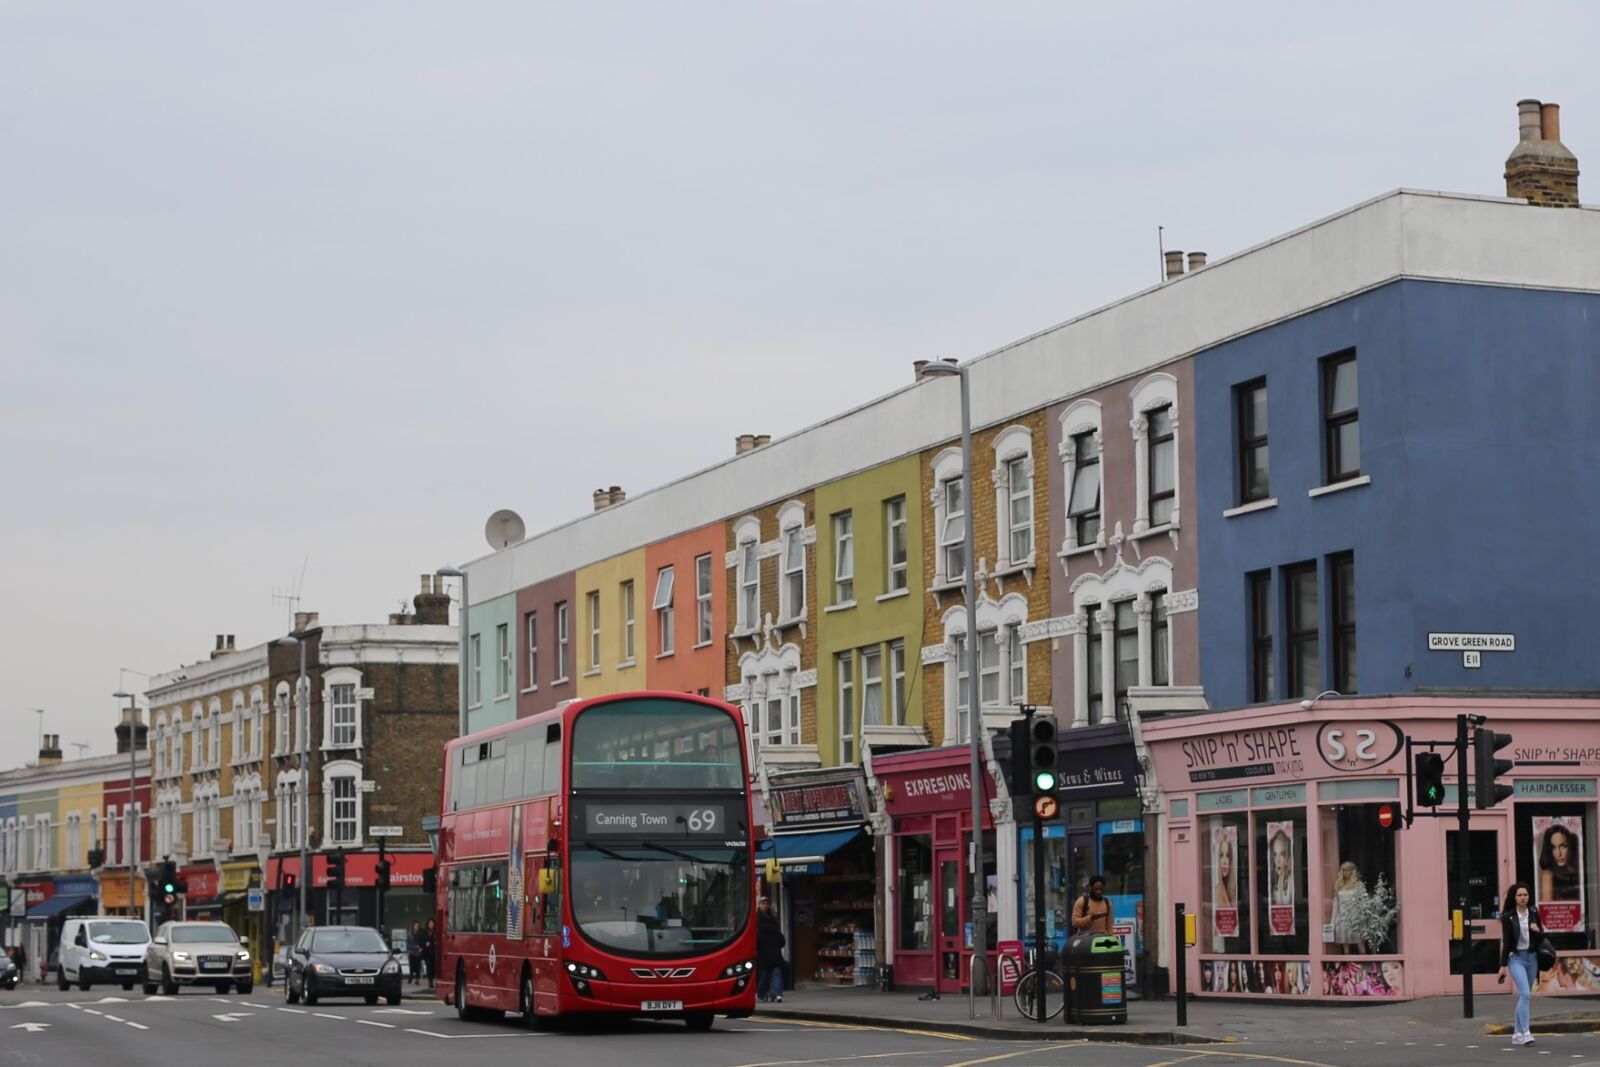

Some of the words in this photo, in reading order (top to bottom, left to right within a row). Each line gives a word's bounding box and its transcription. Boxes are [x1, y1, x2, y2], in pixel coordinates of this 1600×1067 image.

[1431, 637, 1459, 647] GROVE
[1461, 637, 1488, 647] GREEN
[1489, 638, 1512, 647] ROAD
[1466, 654, 1478, 664] E11
[1182, 738, 1217, 768] SNIP
[1243, 728, 1300, 761] SHAPE
[1514, 748, 1542, 760] SNIP
[1058, 772, 1082, 786] News
[1083, 769, 1091, 783] &
[1094, 767, 1122, 782] Wines
[1521, 783, 1586, 793] HAIRDRESSER
[1265, 790, 1296, 801] GENTLEMEN
[595, 813, 637, 828] Canning
[640, 813, 667, 825] Town
[688, 809, 716, 831] 69
